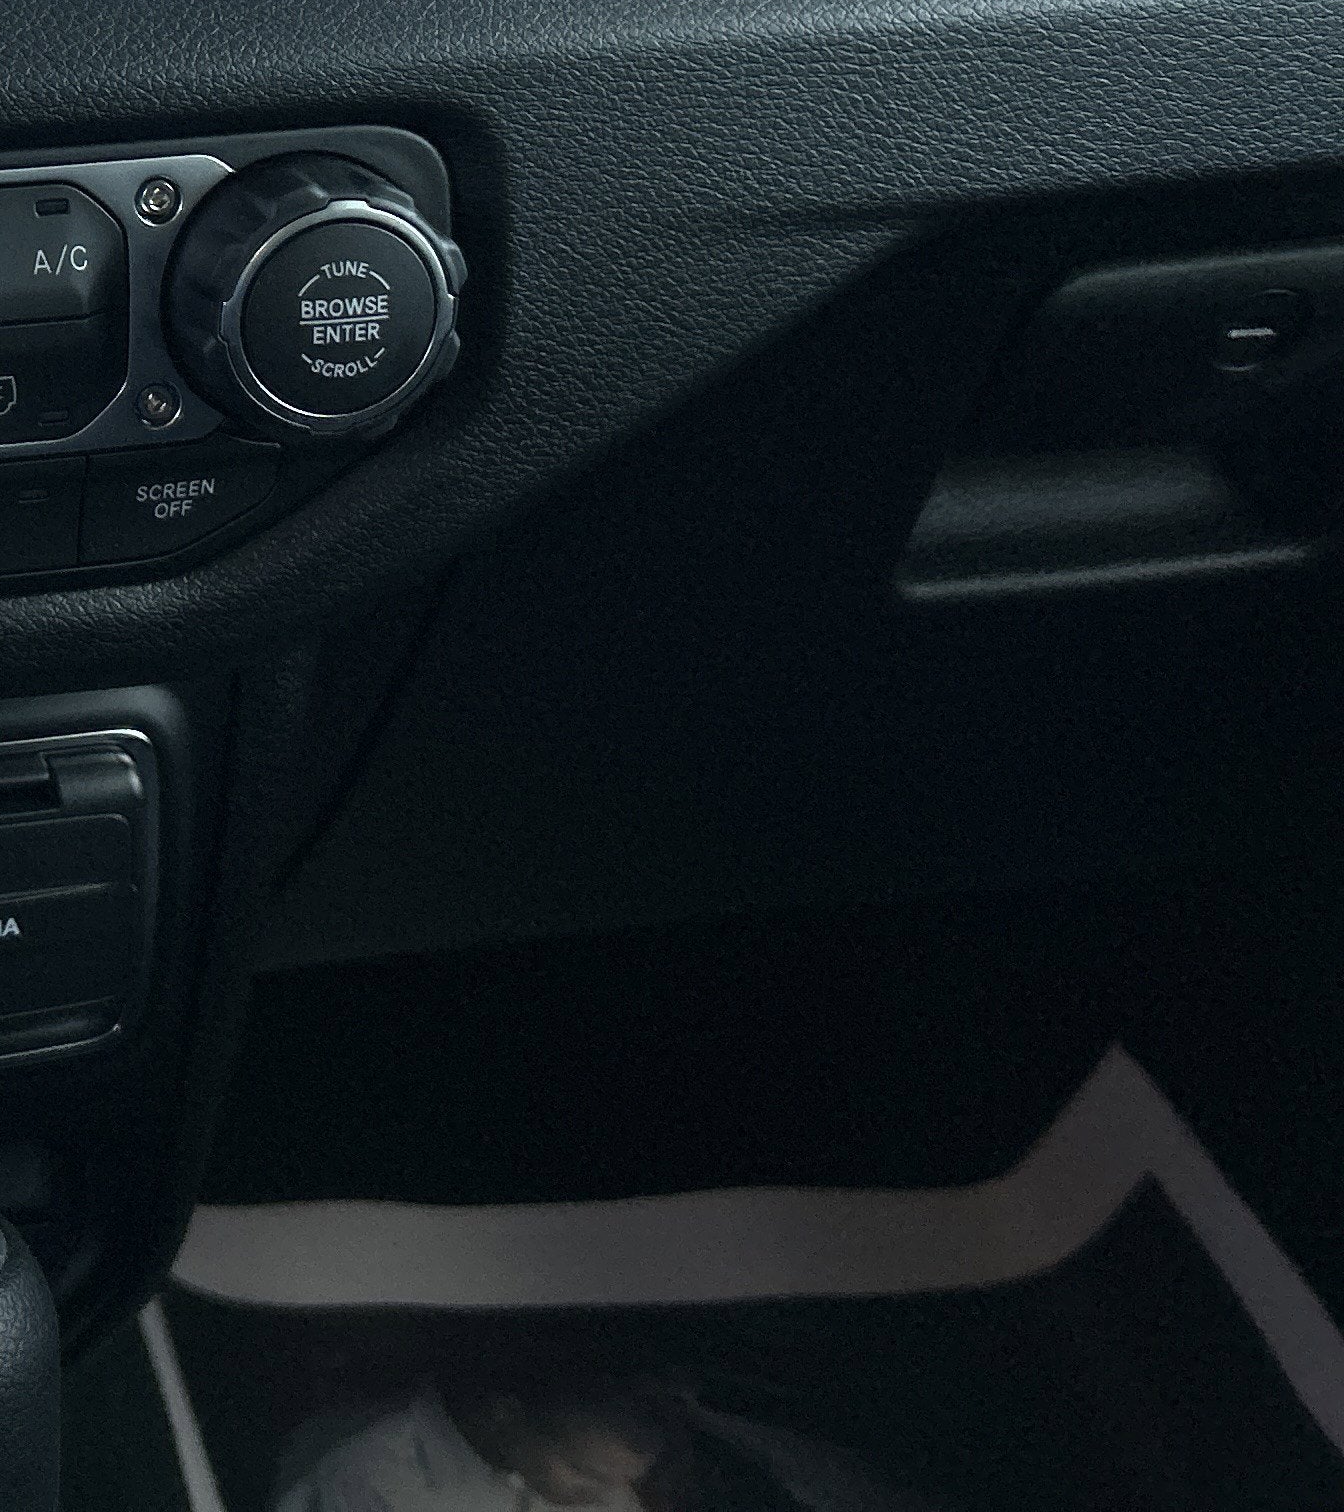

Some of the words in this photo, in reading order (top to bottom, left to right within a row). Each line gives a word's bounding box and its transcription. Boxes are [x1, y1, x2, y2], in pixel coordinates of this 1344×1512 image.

[32, 245, 88, 275] A/C
[320, 260, 371, 280] TUNE
[300, 294, 389, 318] BROWSE
[312, 322, 381, 345] ENTER
[311, 356, 377, 377] SCROLL
[136, 478, 215, 501] SCREEN
[154, 499, 192, 519] OFF
